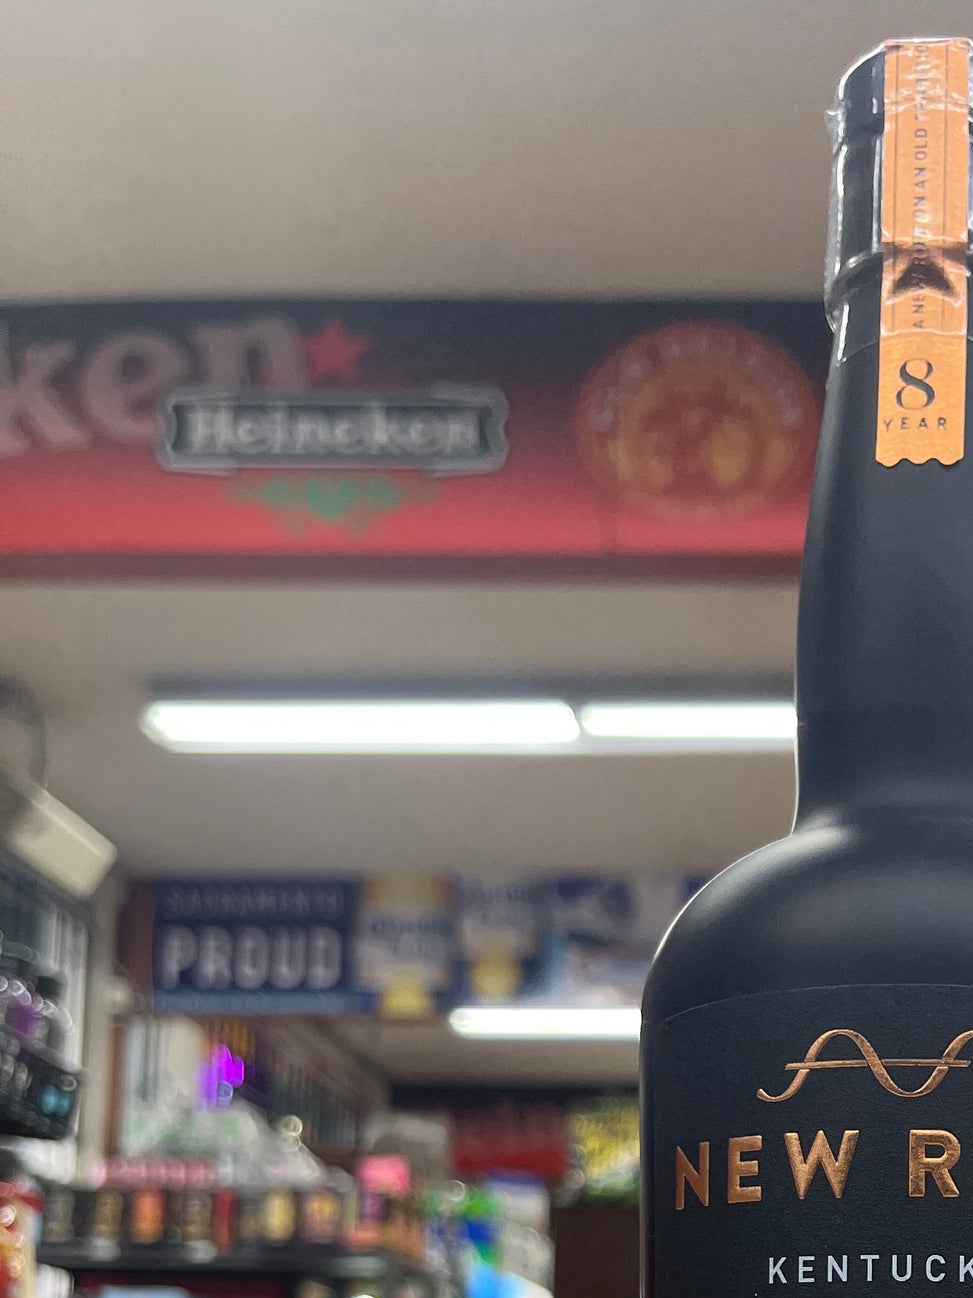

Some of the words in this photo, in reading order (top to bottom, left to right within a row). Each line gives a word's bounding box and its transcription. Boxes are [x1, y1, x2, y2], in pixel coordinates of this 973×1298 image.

[914, 128, 929, 161] OLD
[914, 166, 928, 188] AN
[896, 357, 936, 411] 8
[186, 399, 485, 455] Heineken
[883, 416, 947, 432] YEAR
[160, 924, 345, 991] PROUD
[674, 1129, 860, 1211] NEW
